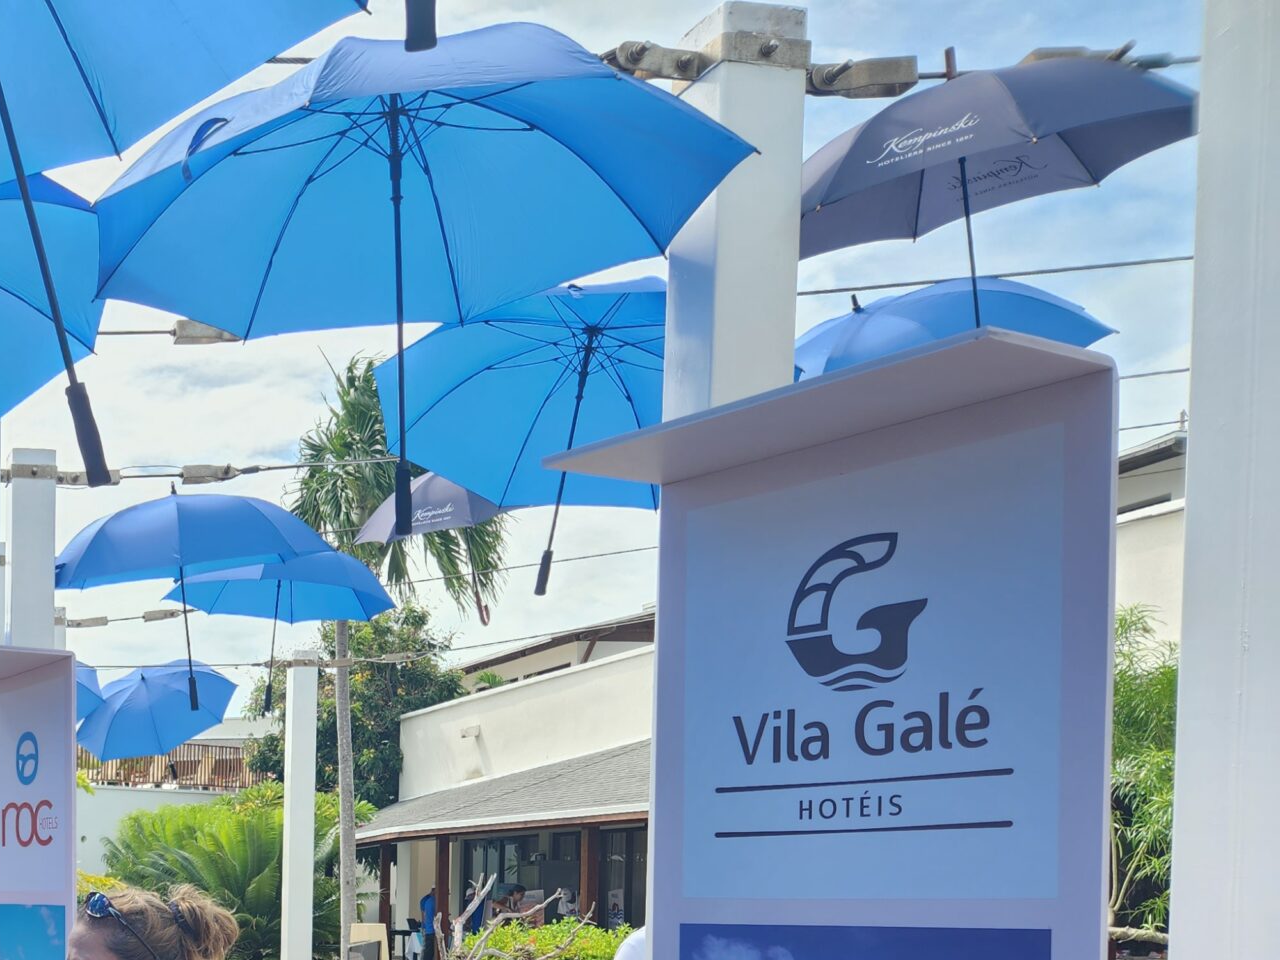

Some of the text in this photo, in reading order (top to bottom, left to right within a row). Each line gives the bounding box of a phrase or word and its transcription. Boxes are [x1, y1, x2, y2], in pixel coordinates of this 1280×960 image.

[866, 112, 980, 164] Kempinski
[732, 687, 990, 765] Vila Galé
[799, 790, 903, 820] HOTÉIS
